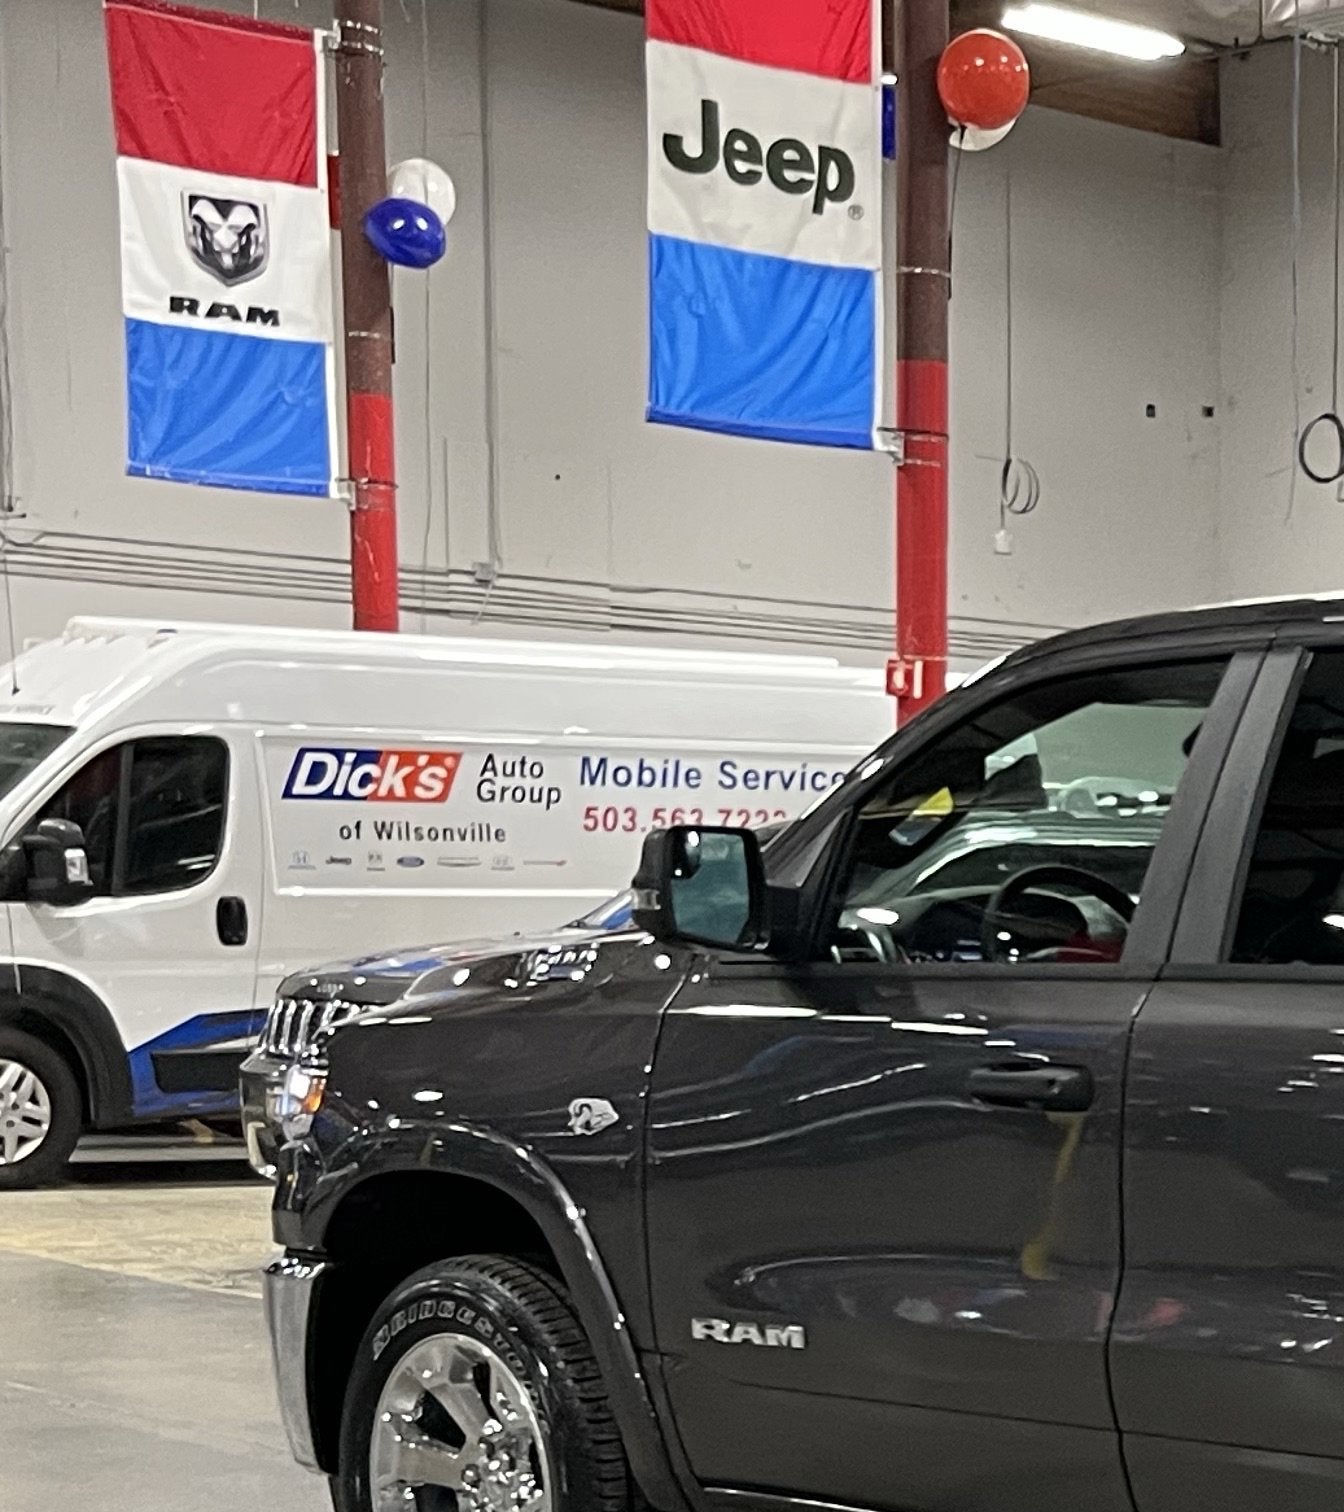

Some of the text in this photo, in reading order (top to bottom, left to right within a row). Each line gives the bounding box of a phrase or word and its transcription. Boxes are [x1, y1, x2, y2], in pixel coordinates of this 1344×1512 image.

[663, 99, 855, 215] Jeep
[169, 296, 280, 326] RAM
[292, 752, 449, 799] Dick's
[480, 752, 545, 780] Auto
[579, 755, 702, 788] Mobile
[476, 778, 562, 811] Group
[339, 820, 507, 843] of Wilsonville
[691, 1318, 806, 1350] RAM
